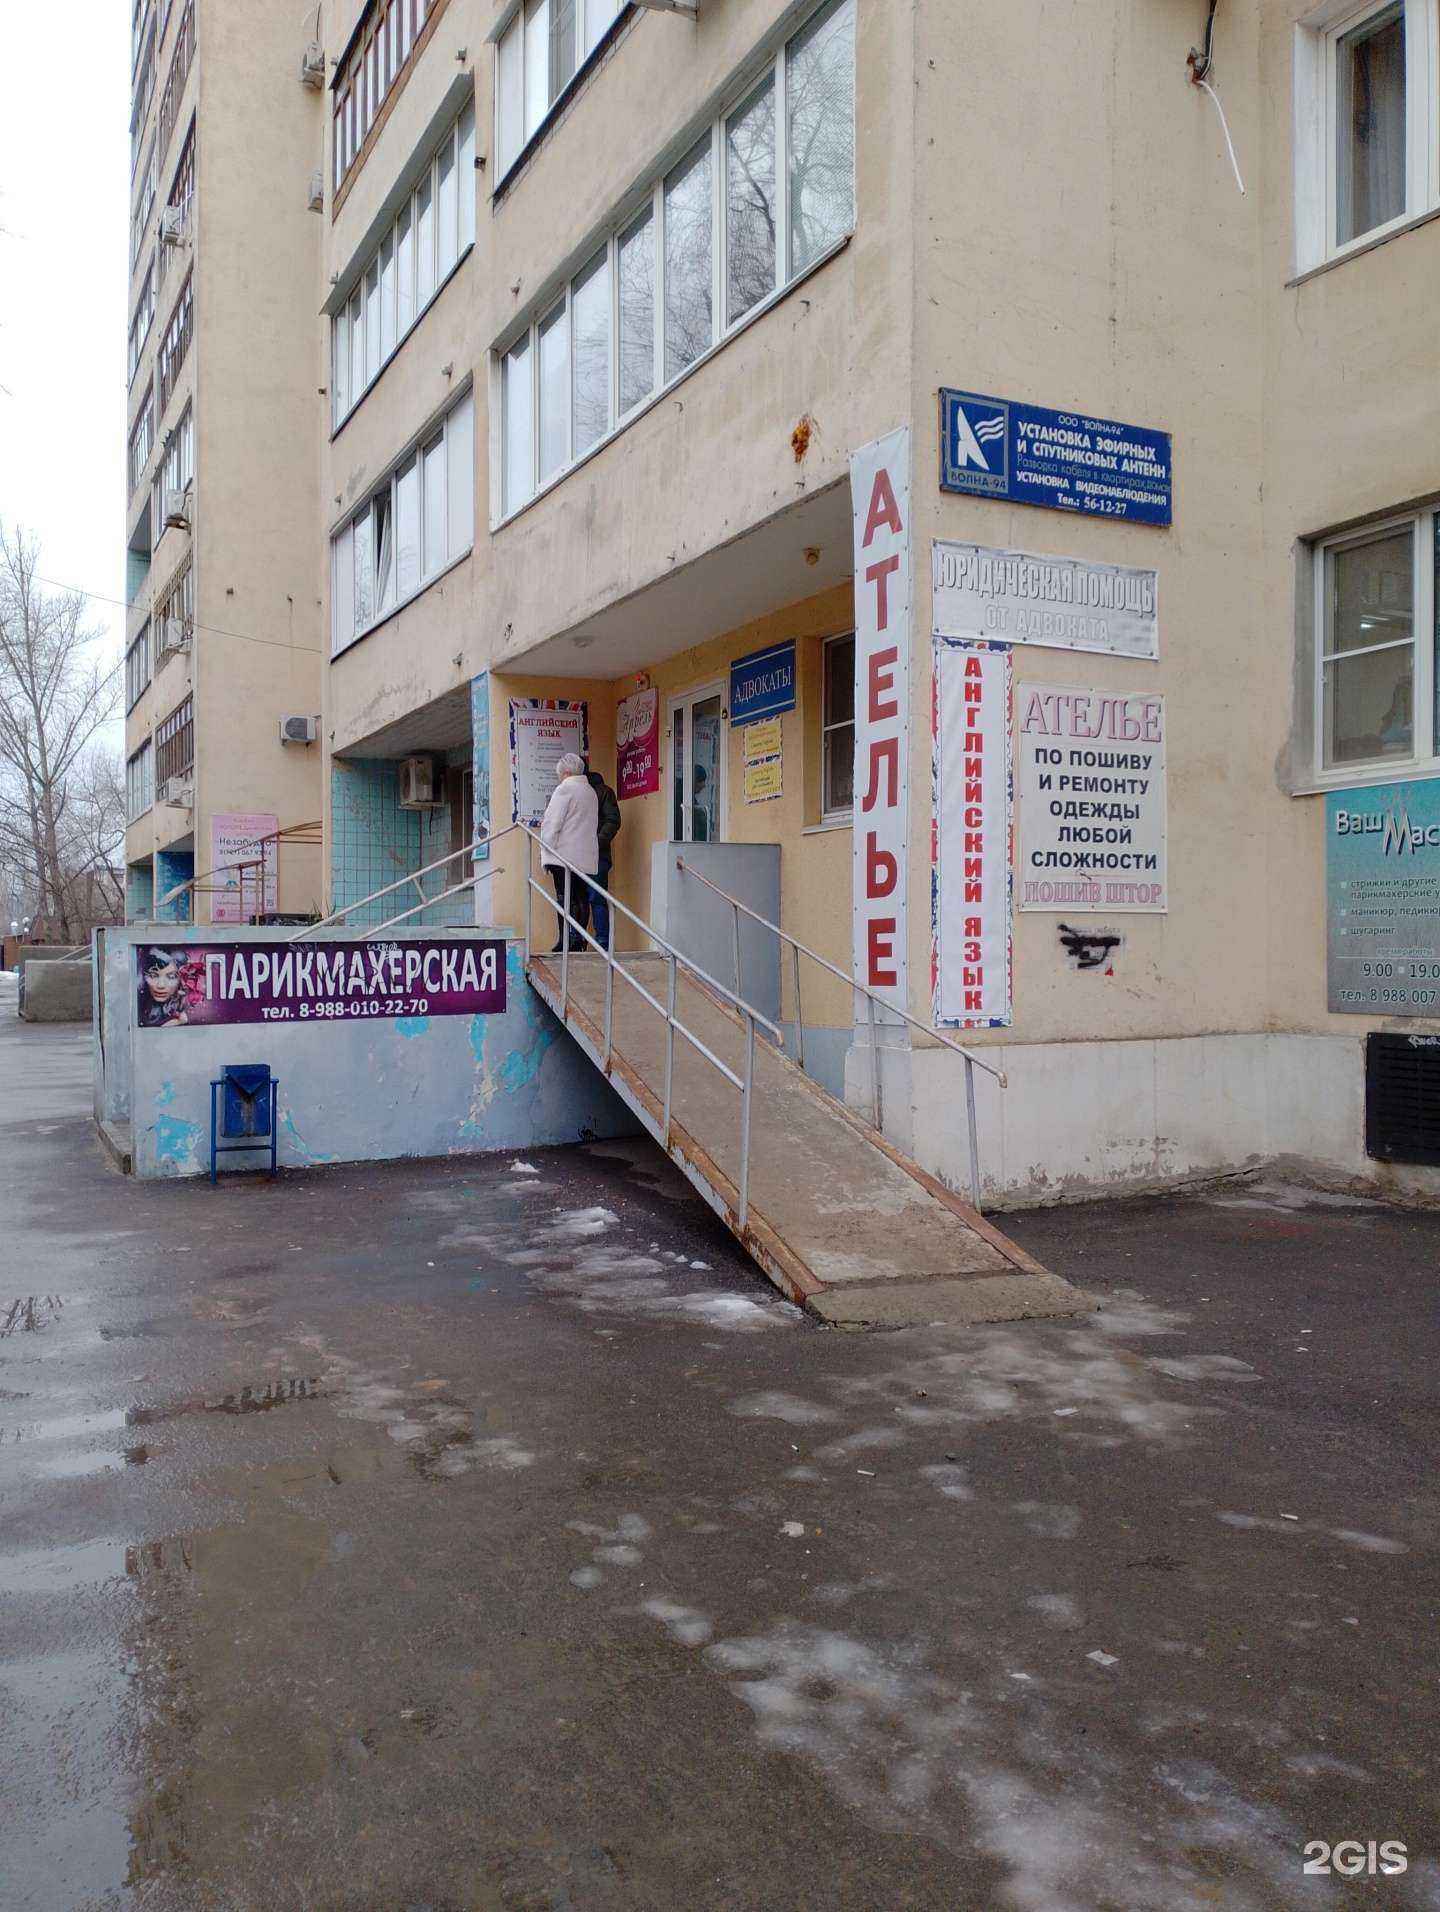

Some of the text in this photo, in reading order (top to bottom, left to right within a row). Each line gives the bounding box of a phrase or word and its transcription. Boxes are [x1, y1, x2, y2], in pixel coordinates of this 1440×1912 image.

[1058, 415, 1078, 427] ООО
[1017, 421, 1156, 462] УСТАНОВКА ЭФИРНЫХ
[1016, 439, 1166, 479] И СПУТНИКОВЫХ АНТЕНН
[1016, 470, 1167, 506] УСТАНОВКА ВИДЕОНАБЛЮДЕНИЯ
[1057, 493, 1127, 515] Тел.: 56-12-27
[935, 551, 1154, 617] ЮРИДИЧЕСКАЯ ПОМОЩЬ
[985, 603, 1109, 641] ОТ АДВОКАТА
[734, 665, 791, 704] АДВОКАТЫ
[519, 717, 578, 729] АНГЛИЙСКИЙ
[862, 468, 903, 986] АТЕЛЬЕ
[1020, 691, 1162, 743] АТЕЛЬЕ
[537, 729, 561, 737] ЯЗЫК
[1035, 748, 1152, 770] ПО ПОШИВУ
[1039, 774, 1149, 795] И РЕМОНТУ
[1049, 801, 1140, 822] ОДЕЖДЫ
[1335, 810, 1384, 835] Ваш
[963, 657, 983, 1011] АНГЛИЙСКИЙ ЯЗЫК
[1058, 825, 1132, 844] ЛЮБОЙ
[1031, 851, 1157, 870] СЛОЖНОСТИ
[1024, 881, 1162, 904] ПОШИВ ШТОР
[1351, 880, 1391, 890] стрижки
[1402, 878, 1437, 888] другие
[1351, 890, 1432, 900] парикмахерские
[1351, 907, 1398, 917] маникюр,
[1351, 927, 1396, 936] шугаринг
[205, 948, 498, 1001] ПАРИКМАХЕРСКАЯ
[1340, 989, 1436, 1003] тел. 8 988 007
[261, 998, 429, 1019] тел. 8-988-010-22-70
